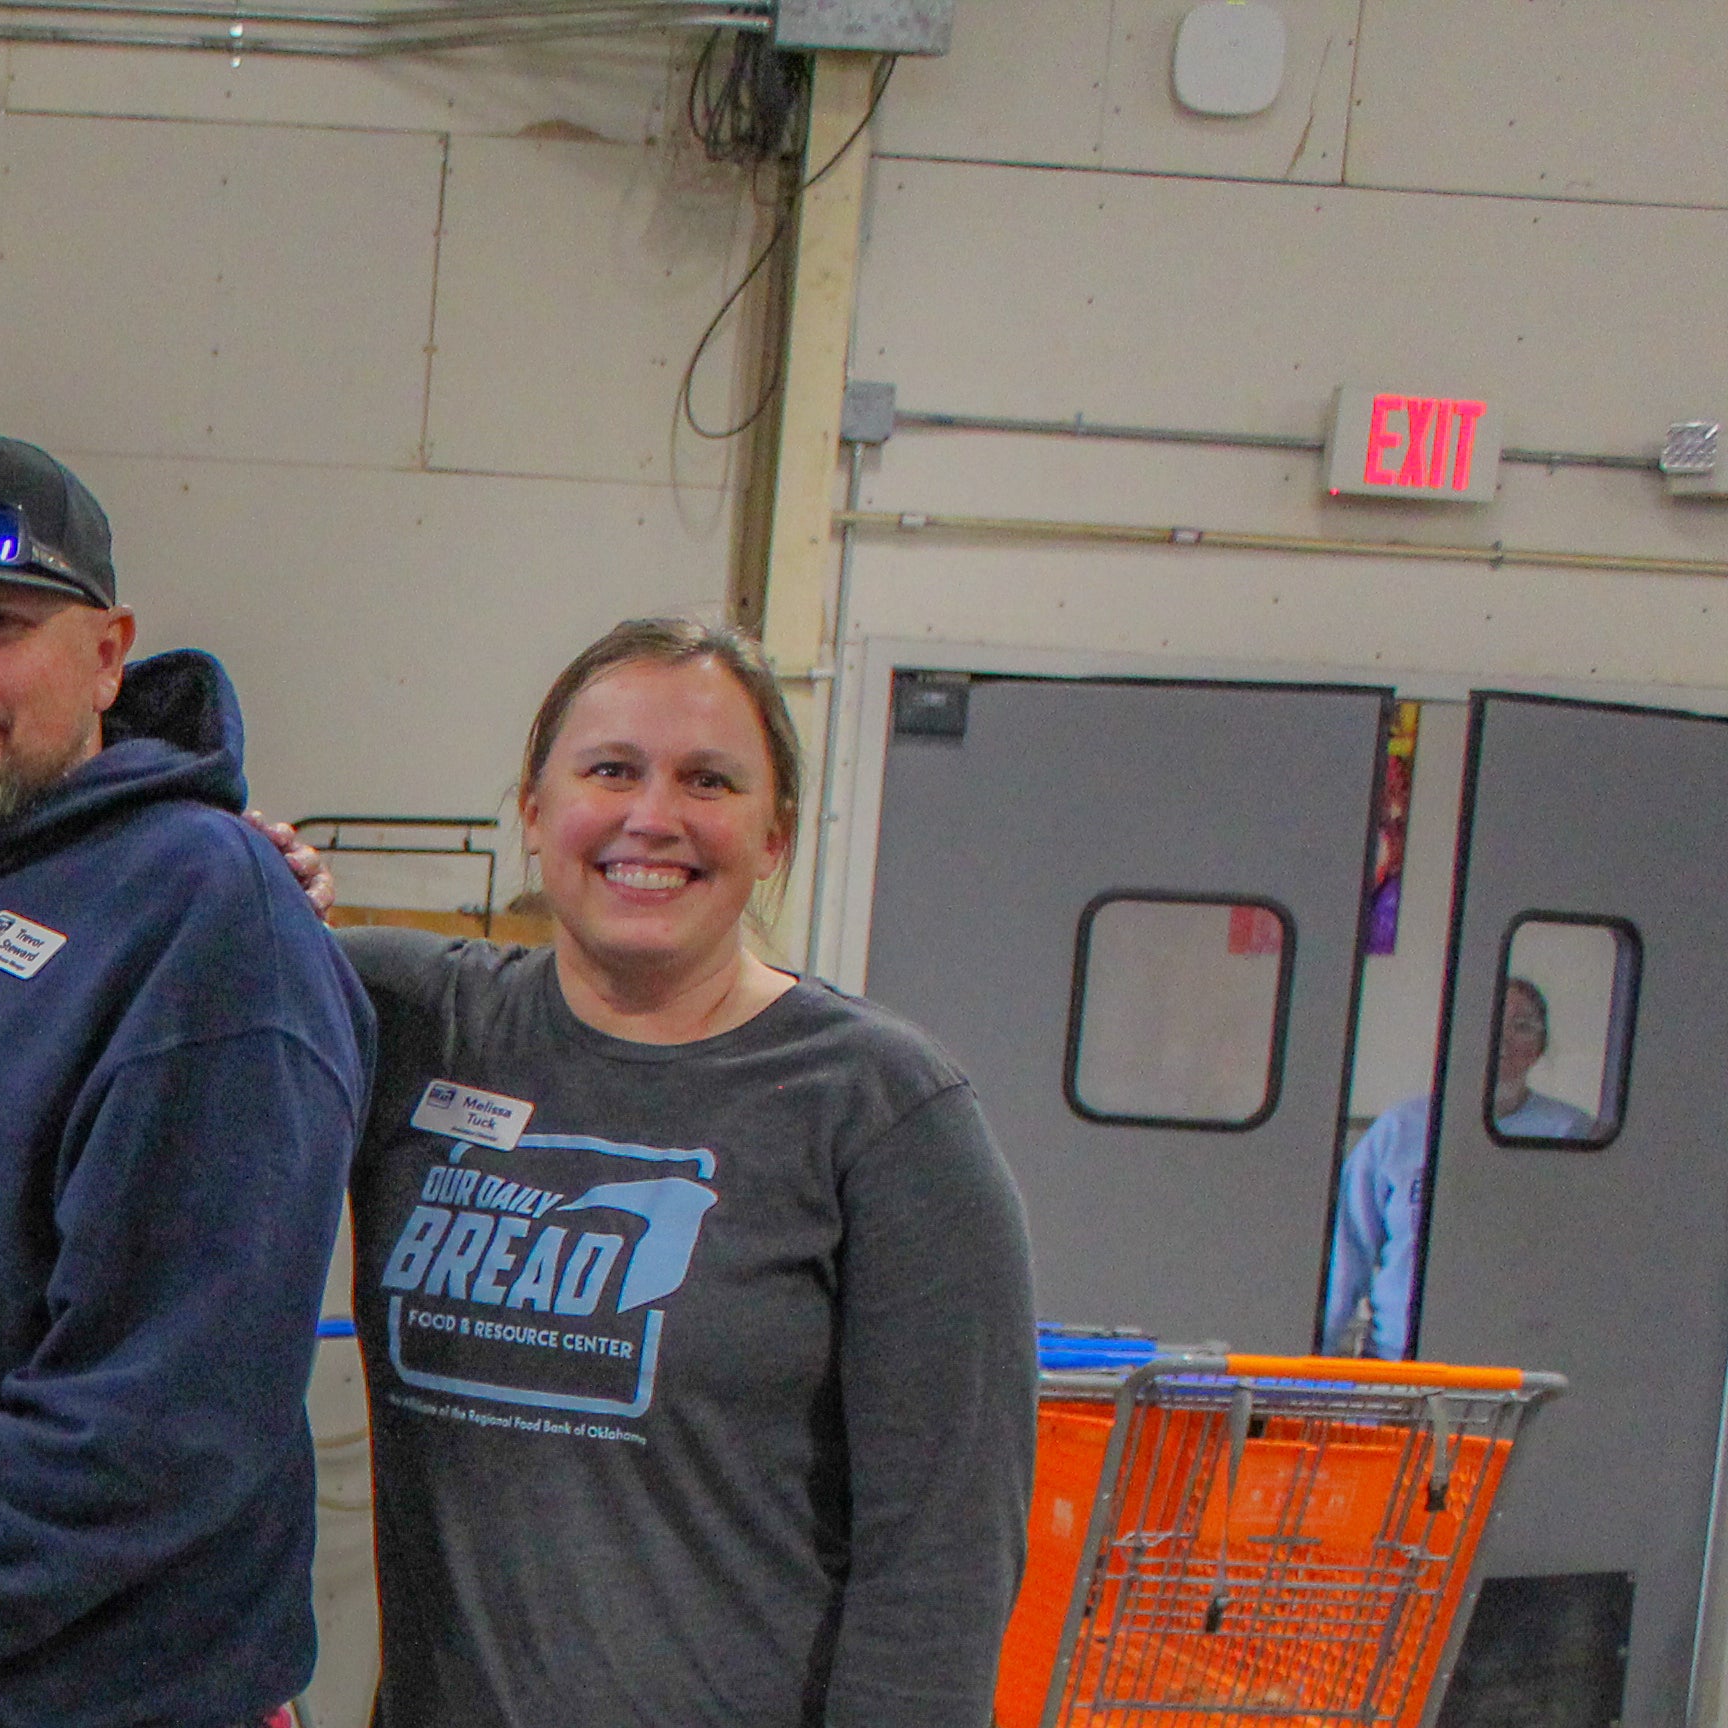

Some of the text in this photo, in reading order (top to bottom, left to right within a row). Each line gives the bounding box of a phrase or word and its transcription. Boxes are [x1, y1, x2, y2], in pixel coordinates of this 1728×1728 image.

[1363, 393, 1488, 491] EXIT
[0, 938, 40, 962] Steward
[16, 928, 45, 949] Trevor
[462, 1095, 513, 1119] Melissa
[467, 1112, 498, 1130] Tuck
[420, 1165, 564, 1220] OUR DAILY
[379, 1204, 625, 1318] BREAD
[407, 1309, 635, 1361] FOOD & RESOURCE CENTER
[468, 1408, 513, 1428] Regional
[513, 1416, 542, 1433] Food
[543, 1419, 572, 1436] Bank
[573, 1422, 586, 1437] of
[587, 1424, 648, 1446] Oklahoma
